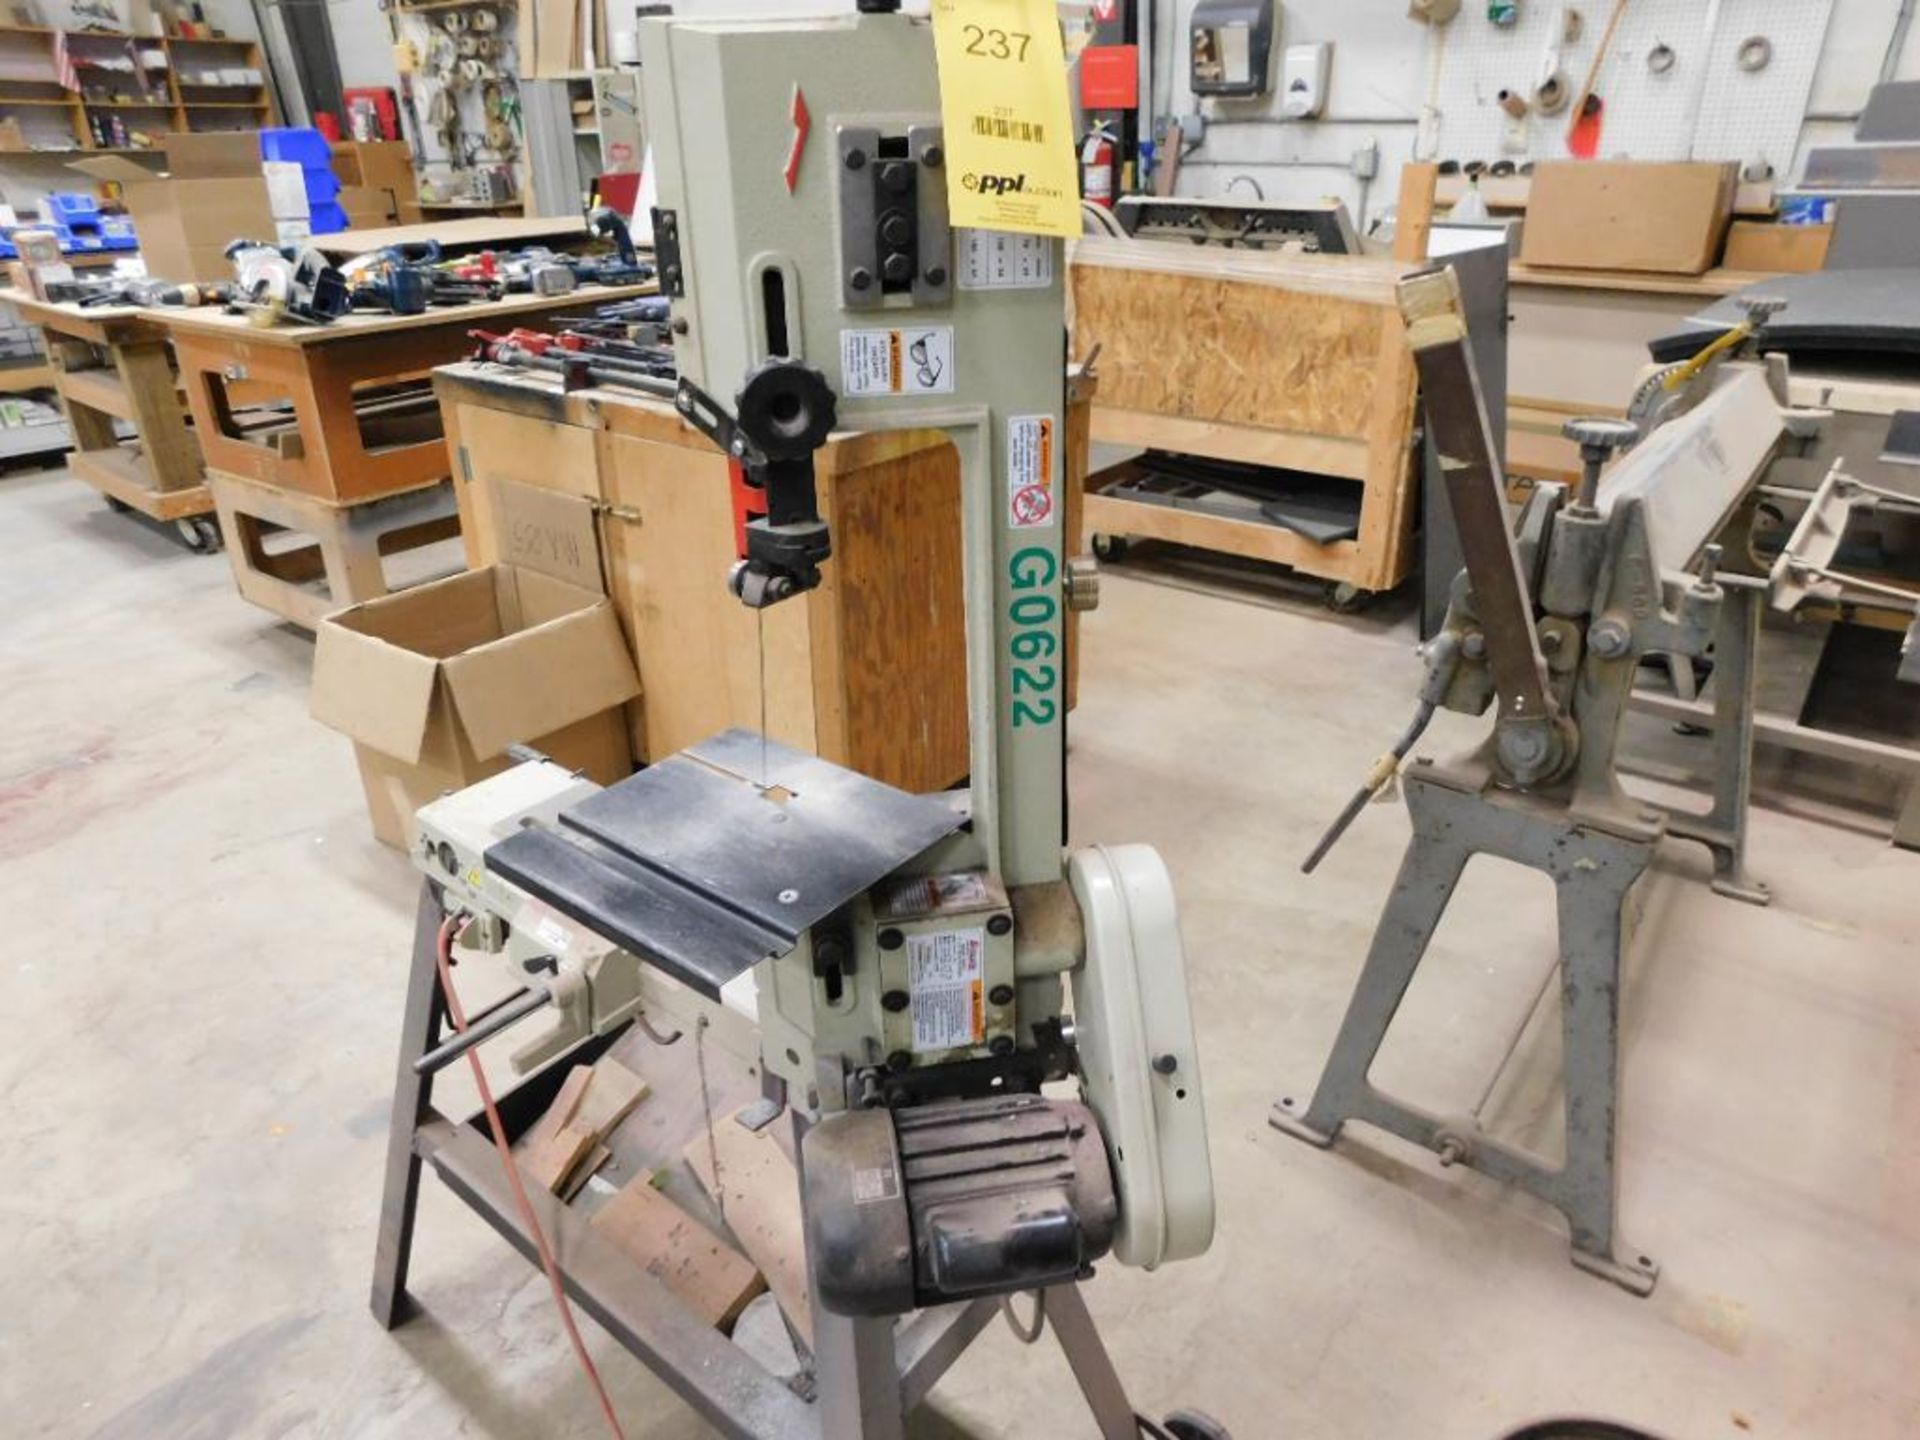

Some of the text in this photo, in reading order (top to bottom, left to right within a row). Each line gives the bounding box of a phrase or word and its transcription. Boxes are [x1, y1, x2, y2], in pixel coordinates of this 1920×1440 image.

[963, 24, 1032, 62] 237
[978, 173, 1025, 195] ppl
[1009, 546, 1057, 728] G0622
